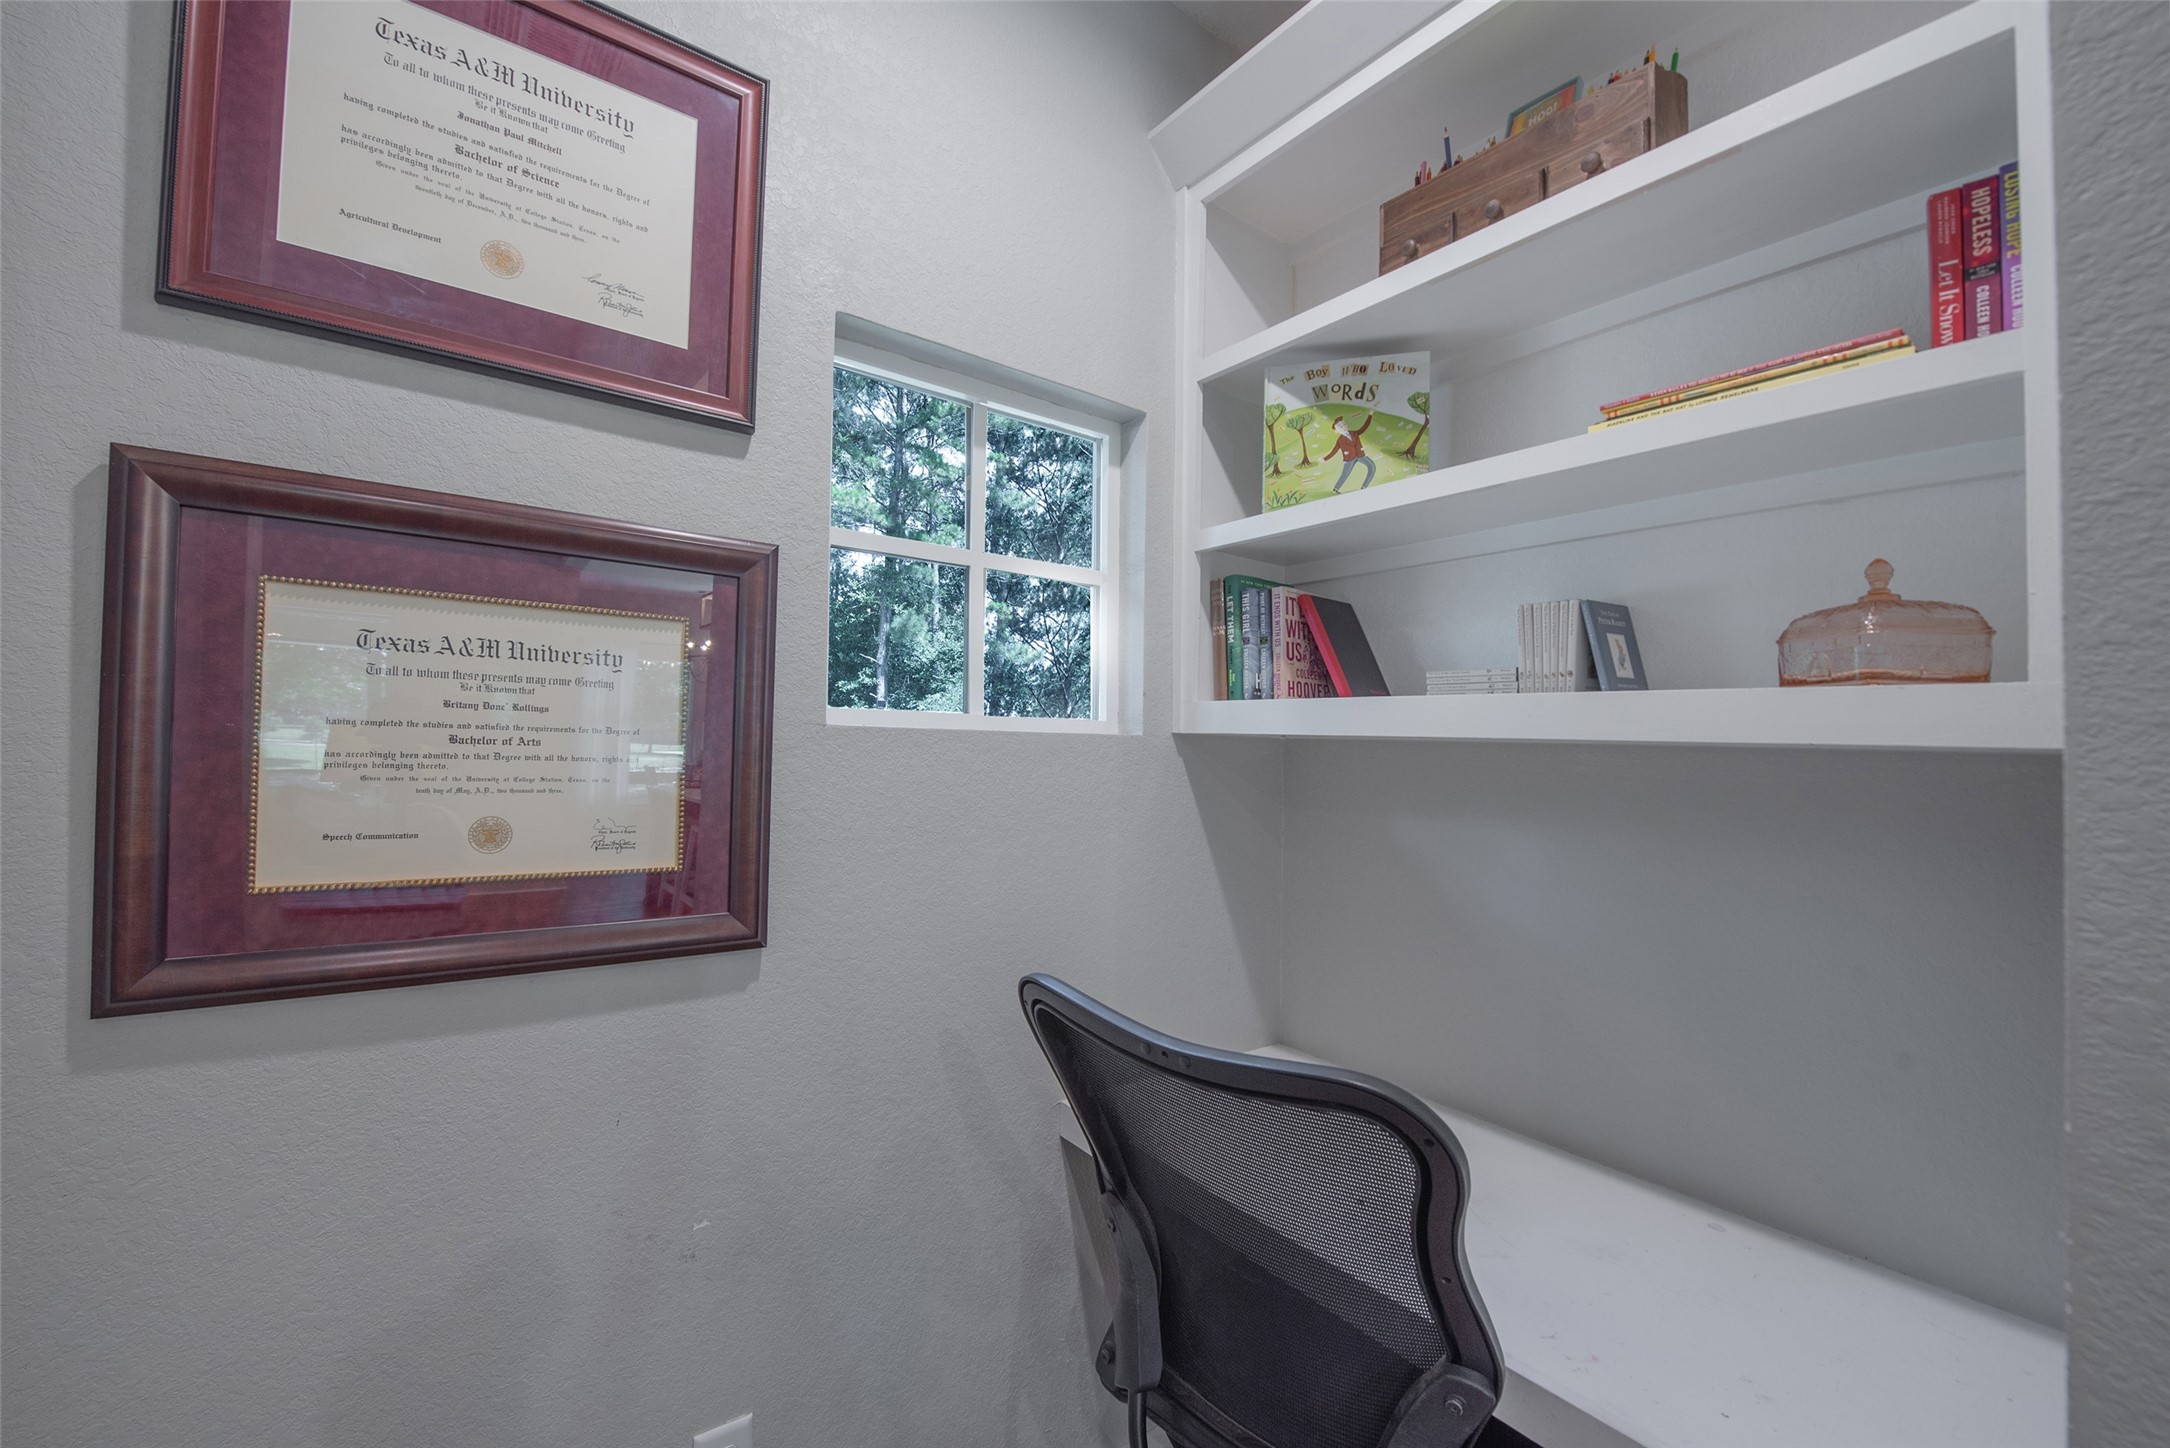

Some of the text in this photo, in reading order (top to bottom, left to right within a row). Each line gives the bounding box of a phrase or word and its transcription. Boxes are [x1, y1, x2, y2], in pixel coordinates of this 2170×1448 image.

[375, 16, 634, 140] Texas A&M University
[383, 51, 626, 154] To all to whom these presents may come Greeting
[473, 98, 548, 134] Be it Known that
[343, 92, 374, 112] having
[376, 106, 419, 125] completed
[422, 120, 435, 130] the
[438, 127, 468, 142] studies
[470, 138, 486, 148] and
[488, 145, 523, 161] satisfied
[525, 156, 538, 166] the
[539, 162, 588, 184] requirements
[590, 178, 600, 188] for
[602, 184, 614, 193] the
[616, 186, 640, 203] Degree
[456, 110, 562, 156] Jonathan Paul Mitchell
[340, 136, 384, 155] privileges
[387, 149, 429, 172] belonging
[454, 143, 560, 189] Bachelor of Science
[341, 123, 358, 136] has
[361, 132, 412, 157] accordingly
[414, 148, 434, 161] been
[436, 157, 473, 173] admitted
[475, 169, 484, 177] to
[486, 172, 503, 184] that
[506, 176, 534, 194] Degree
[536, 190, 553, 201] with
[555, 197, 566, 205] all
[568, 200, 580, 210] the
[612, 216, 633, 228] rights
[635, 225, 648, 233] and
[338, 208, 442, 244] Agricultural Development
[1971, 186, 1992, 257] HOPELESS
[1938, 258, 1959, 288] Let
[1939, 288, 1960, 302] It
[1976, 285, 1990, 323] COLLEEN
[1939, 304, 1960, 344] Snow
[1280, 375, 1295, 385] The
[1306, 368, 1328, 380] Boy
[356, 628, 624, 674] Texas A&M University
[1274, 638, 1281, 648] US
[1286, 641, 1302, 662] US
[365, 662, 614, 692] To all to whom these presents may come Greeting
[458, 681, 536, 696] Be it Known that
[325, 716, 357, 728] having
[360, 719, 404, 728] completed
[406, 719, 420, 728] the
[422, 721, 454, 729] studies
[456, 722, 472, 730] and
[474, 722, 510, 731] satisfied
[512, 723, 525, 732] the
[527, 725, 576, 734] requirements
[448, 734, 542, 748] Bachelor of Arts
[323, 760, 368, 772] privileges
[371, 760, 416, 772] belonging
[324, 749, 342, 758] has
[345, 750, 397, 762] accordingly
[400, 750, 419, 759] been
[422, 752, 459, 760] admitted
[462, 752, 470, 760] to
[473, 752, 490, 760] that
[492, 751, 522, 763] Degree
[524, 753, 542, 762] with
[544, 754, 554, 762] all
[556, 754, 568, 762] the
[322, 832, 419, 842] Speech Communication
